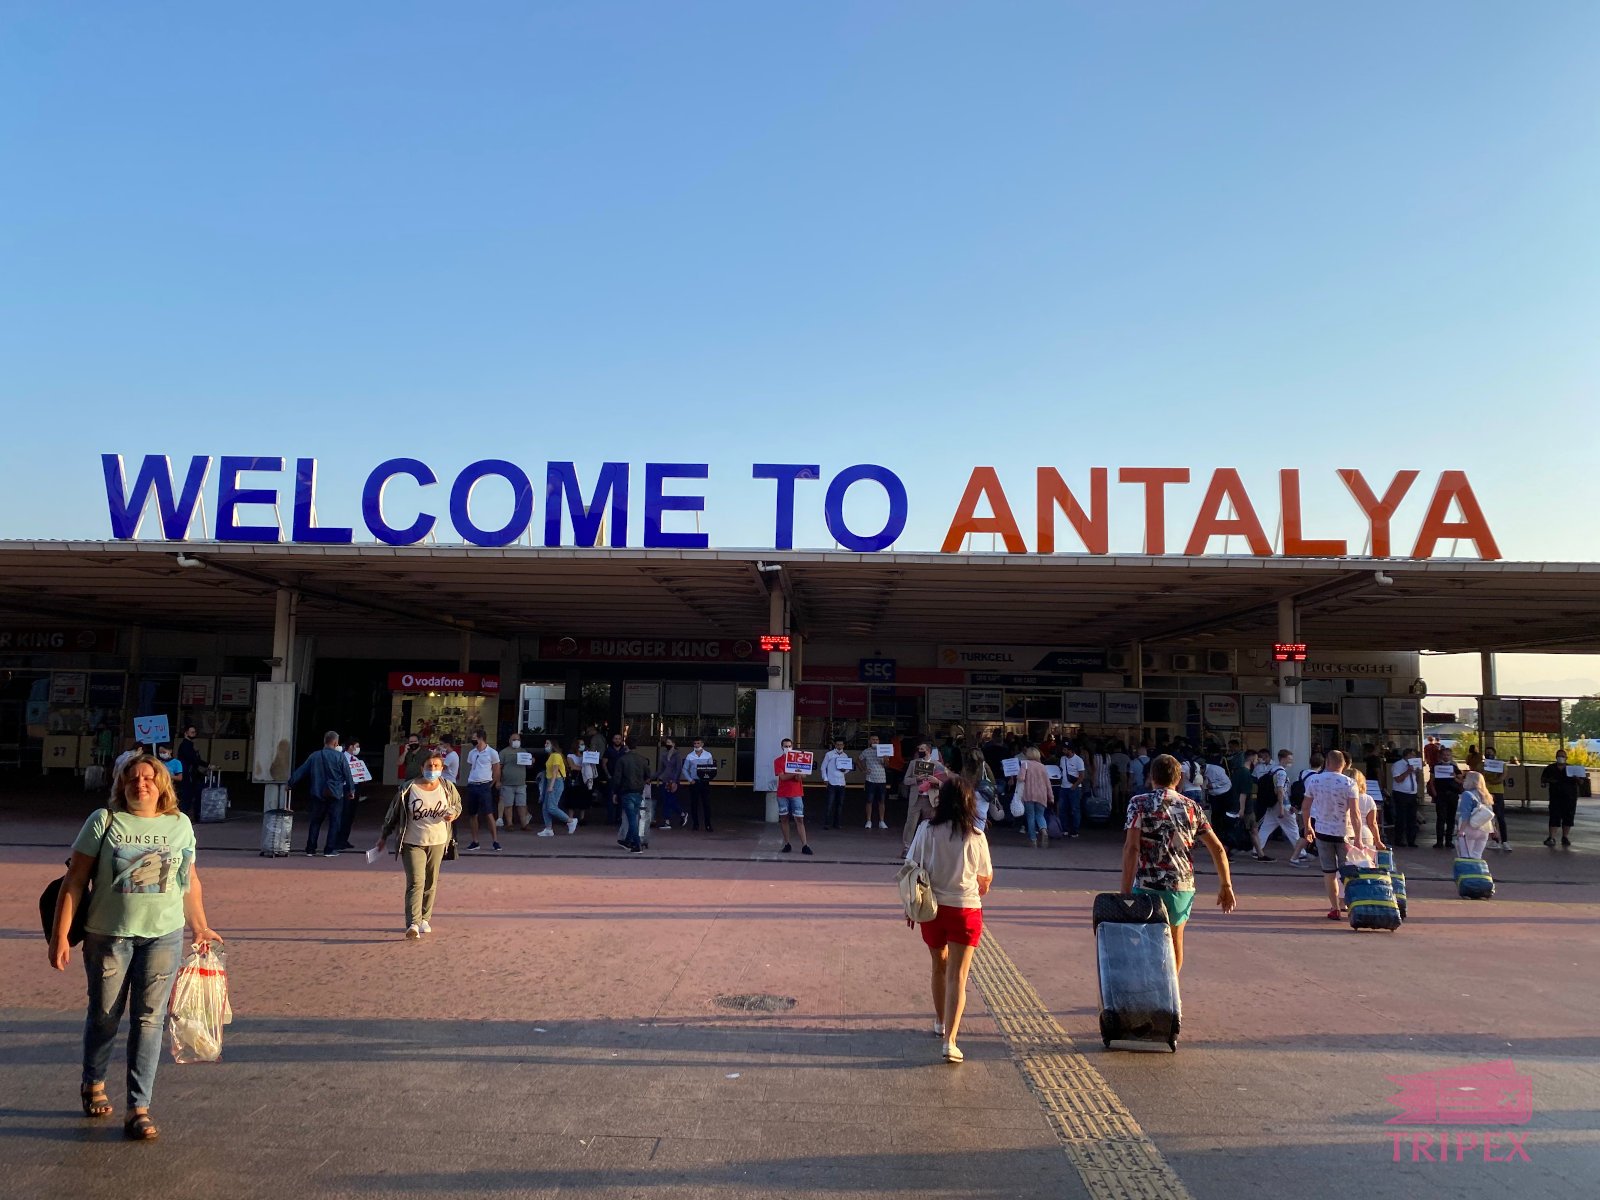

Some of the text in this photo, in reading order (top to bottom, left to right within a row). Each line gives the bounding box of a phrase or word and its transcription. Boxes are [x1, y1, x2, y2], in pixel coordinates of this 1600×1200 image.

[102, 453, 1503, 560] WELCOME TO ANTALYA
[16, 632, 65, 648] KING
[590, 640, 720, 660] BURGER KING
[960, 653, 1015, 664] TURKCELL
[863, 662, 892, 681] SEÇ
[414, 676, 465, 687] vodafone
[115, 834, 168, 845] SUNSET
